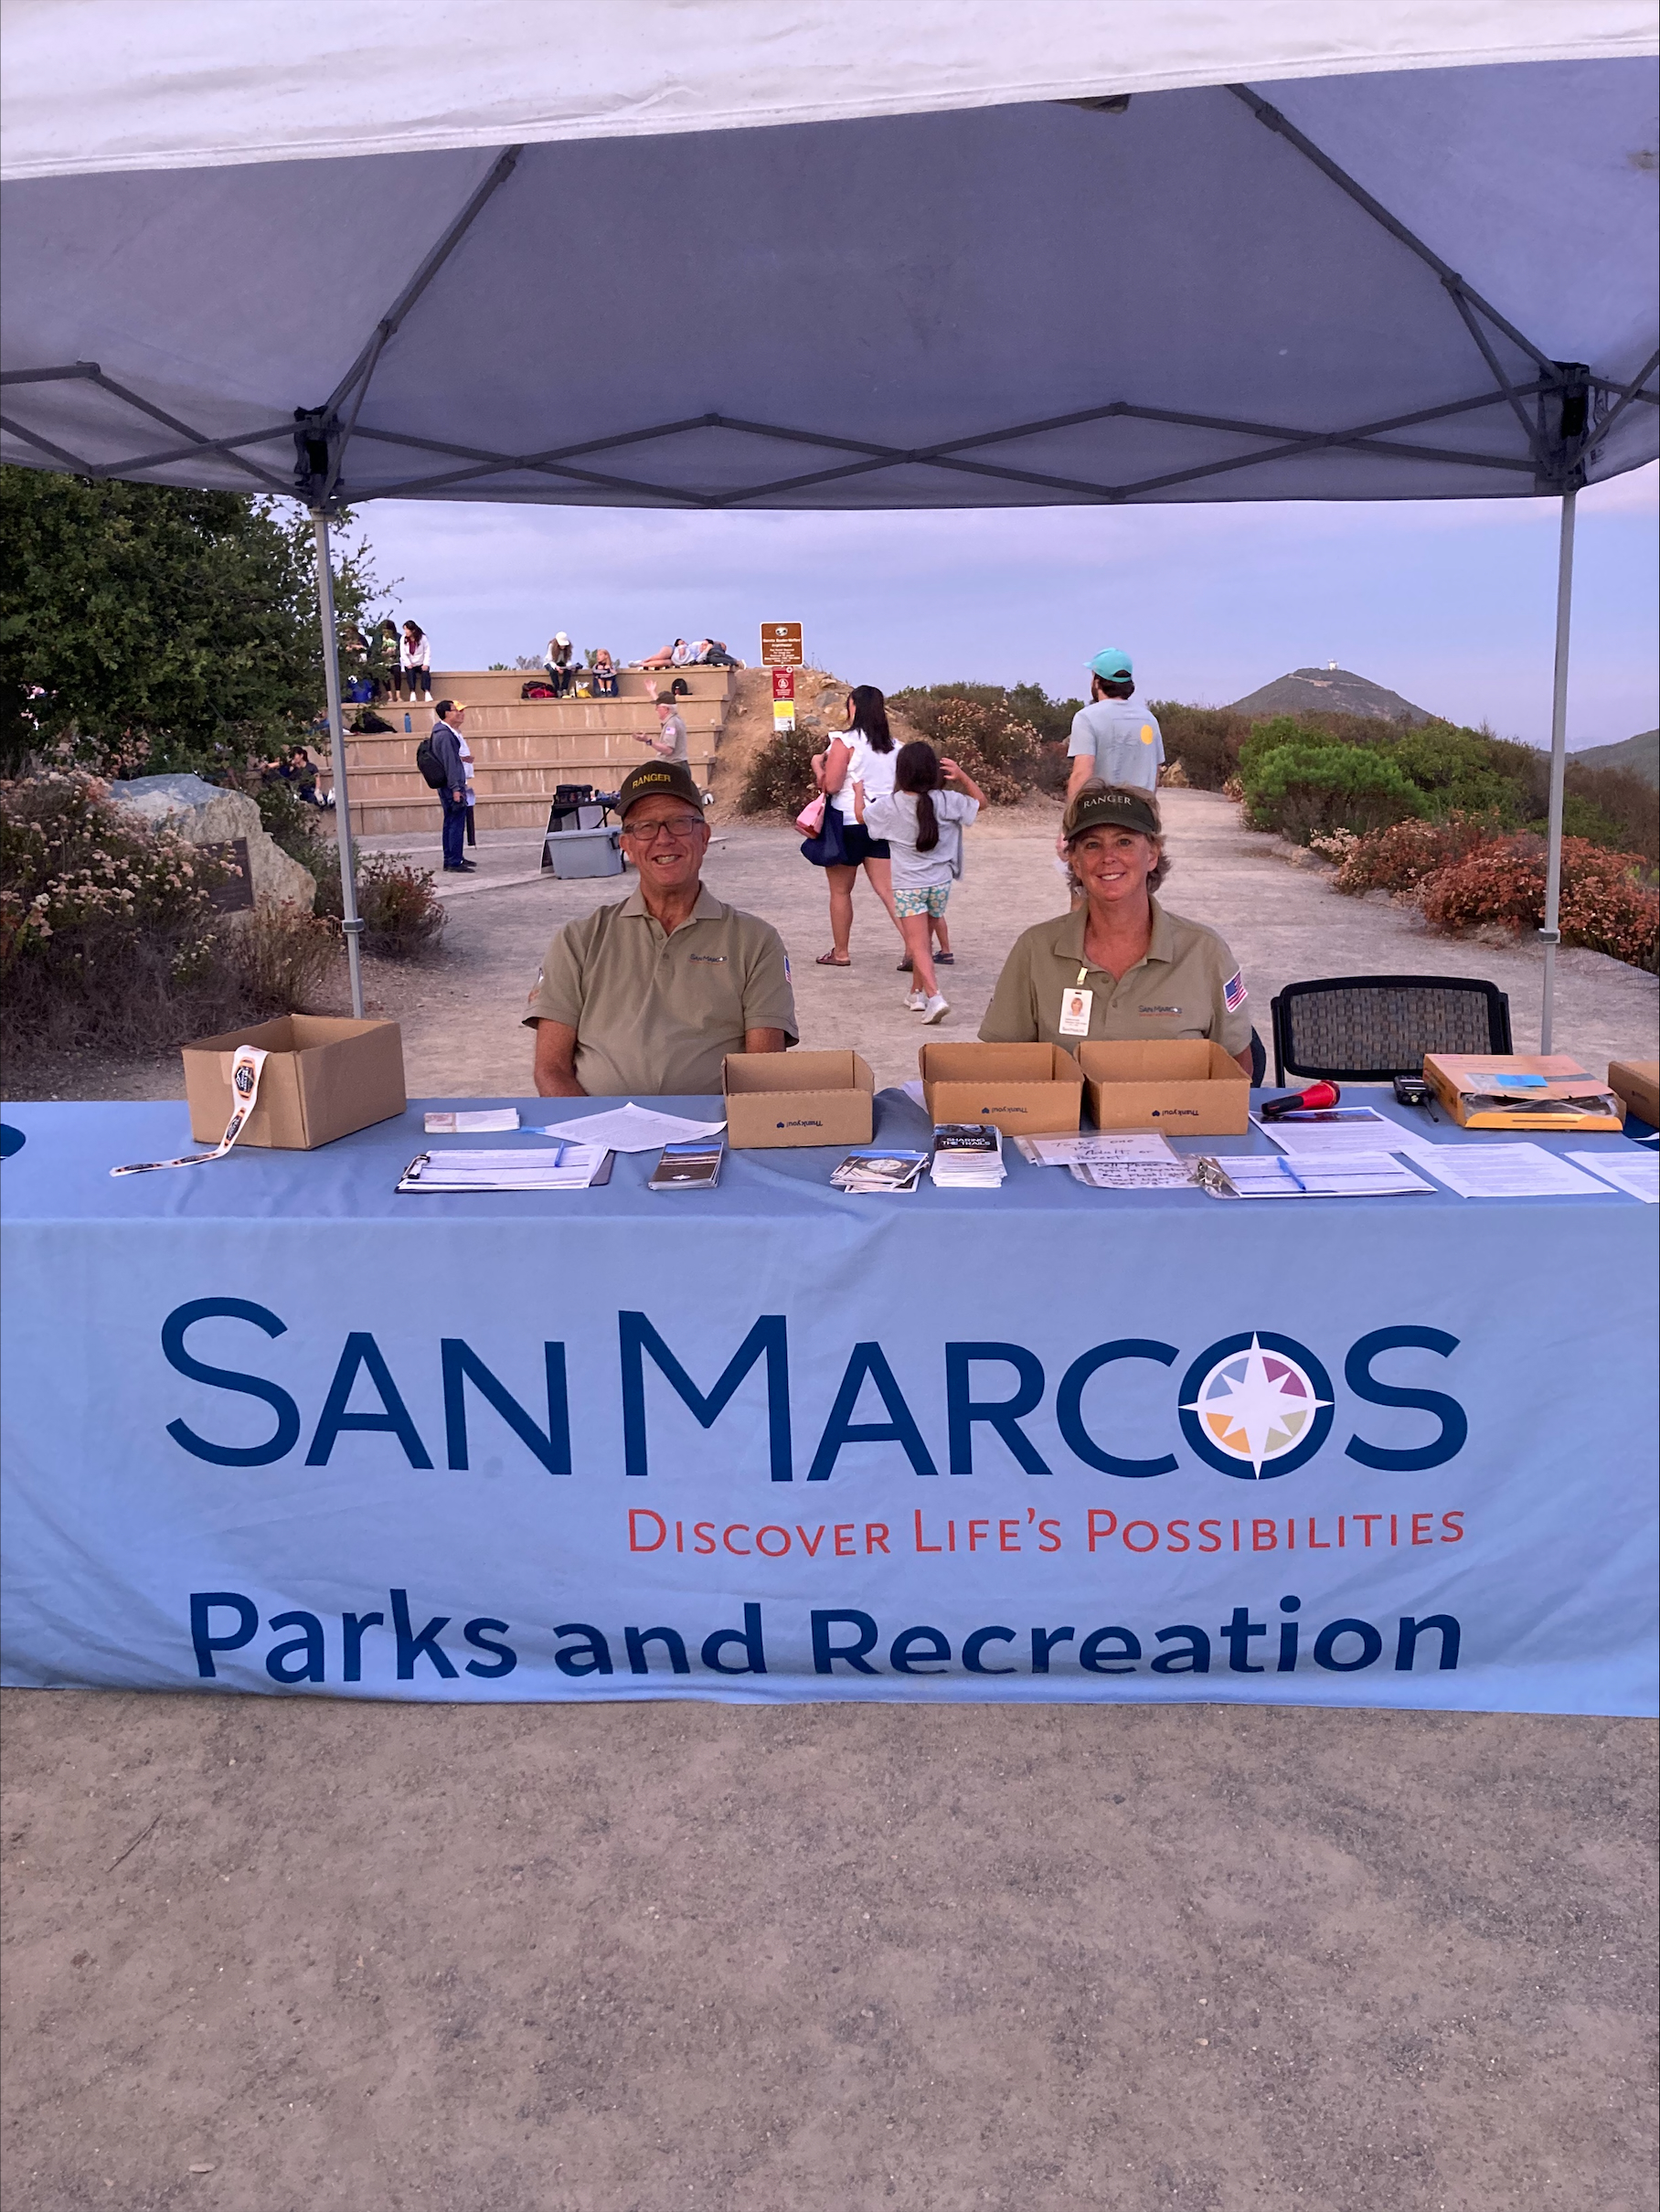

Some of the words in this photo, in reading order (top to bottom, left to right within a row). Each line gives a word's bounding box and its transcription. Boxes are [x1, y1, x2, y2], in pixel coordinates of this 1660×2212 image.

[632, 772, 671, 790] RANGER
[1083, 794, 1132, 808] RANGER
[161, 1296, 572, 1475] SAN
[618, 1310, 1468, 1482] MARCOS
[628, 1509, 890, 1558] DISCOVER
[914, 1507, 1062, 1554] LIFE'S
[1087, 1508, 1465, 1553] POSSIBILITIES
[189, 1589, 517, 1684] Parks
[553, 1602, 768, 1676] and
[810, 1595, 1462, 1675] Recreation
